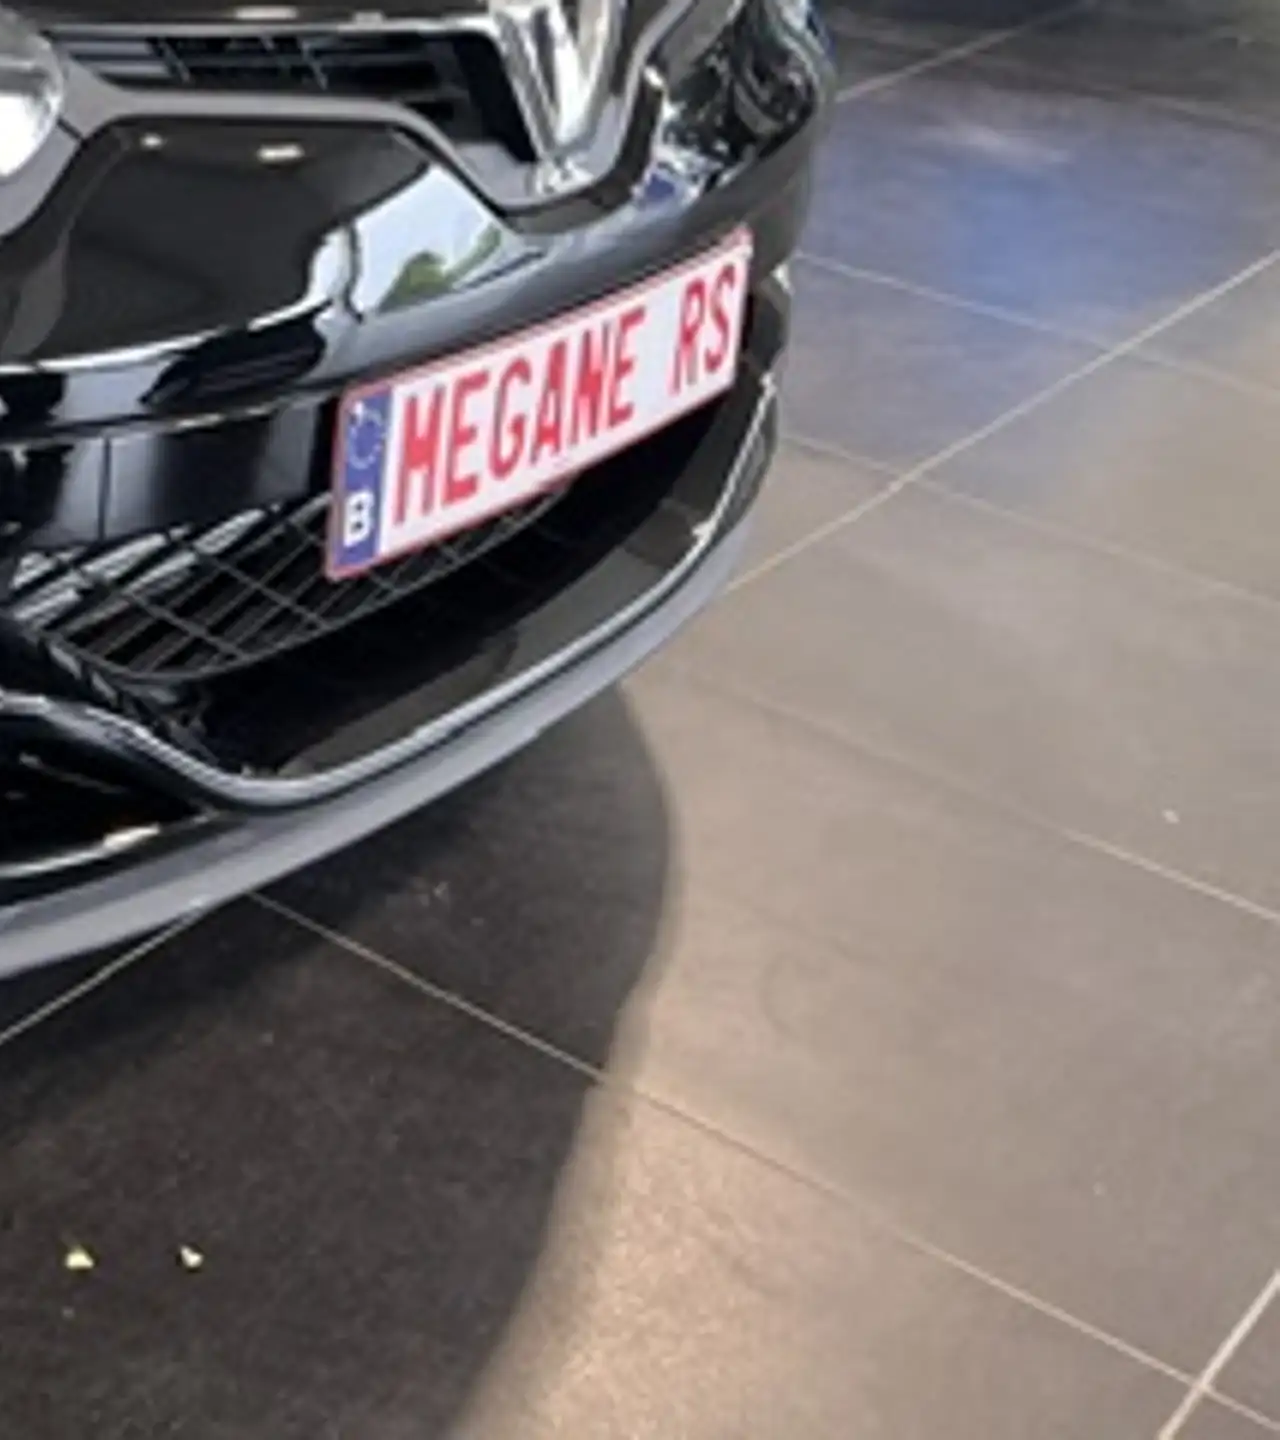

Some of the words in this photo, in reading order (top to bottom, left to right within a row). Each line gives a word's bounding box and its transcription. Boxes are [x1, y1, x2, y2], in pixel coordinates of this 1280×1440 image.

[393, 306, 646, 524] MEGANE
[668, 262, 737, 397] RS
[343, 491, 372, 548] B
